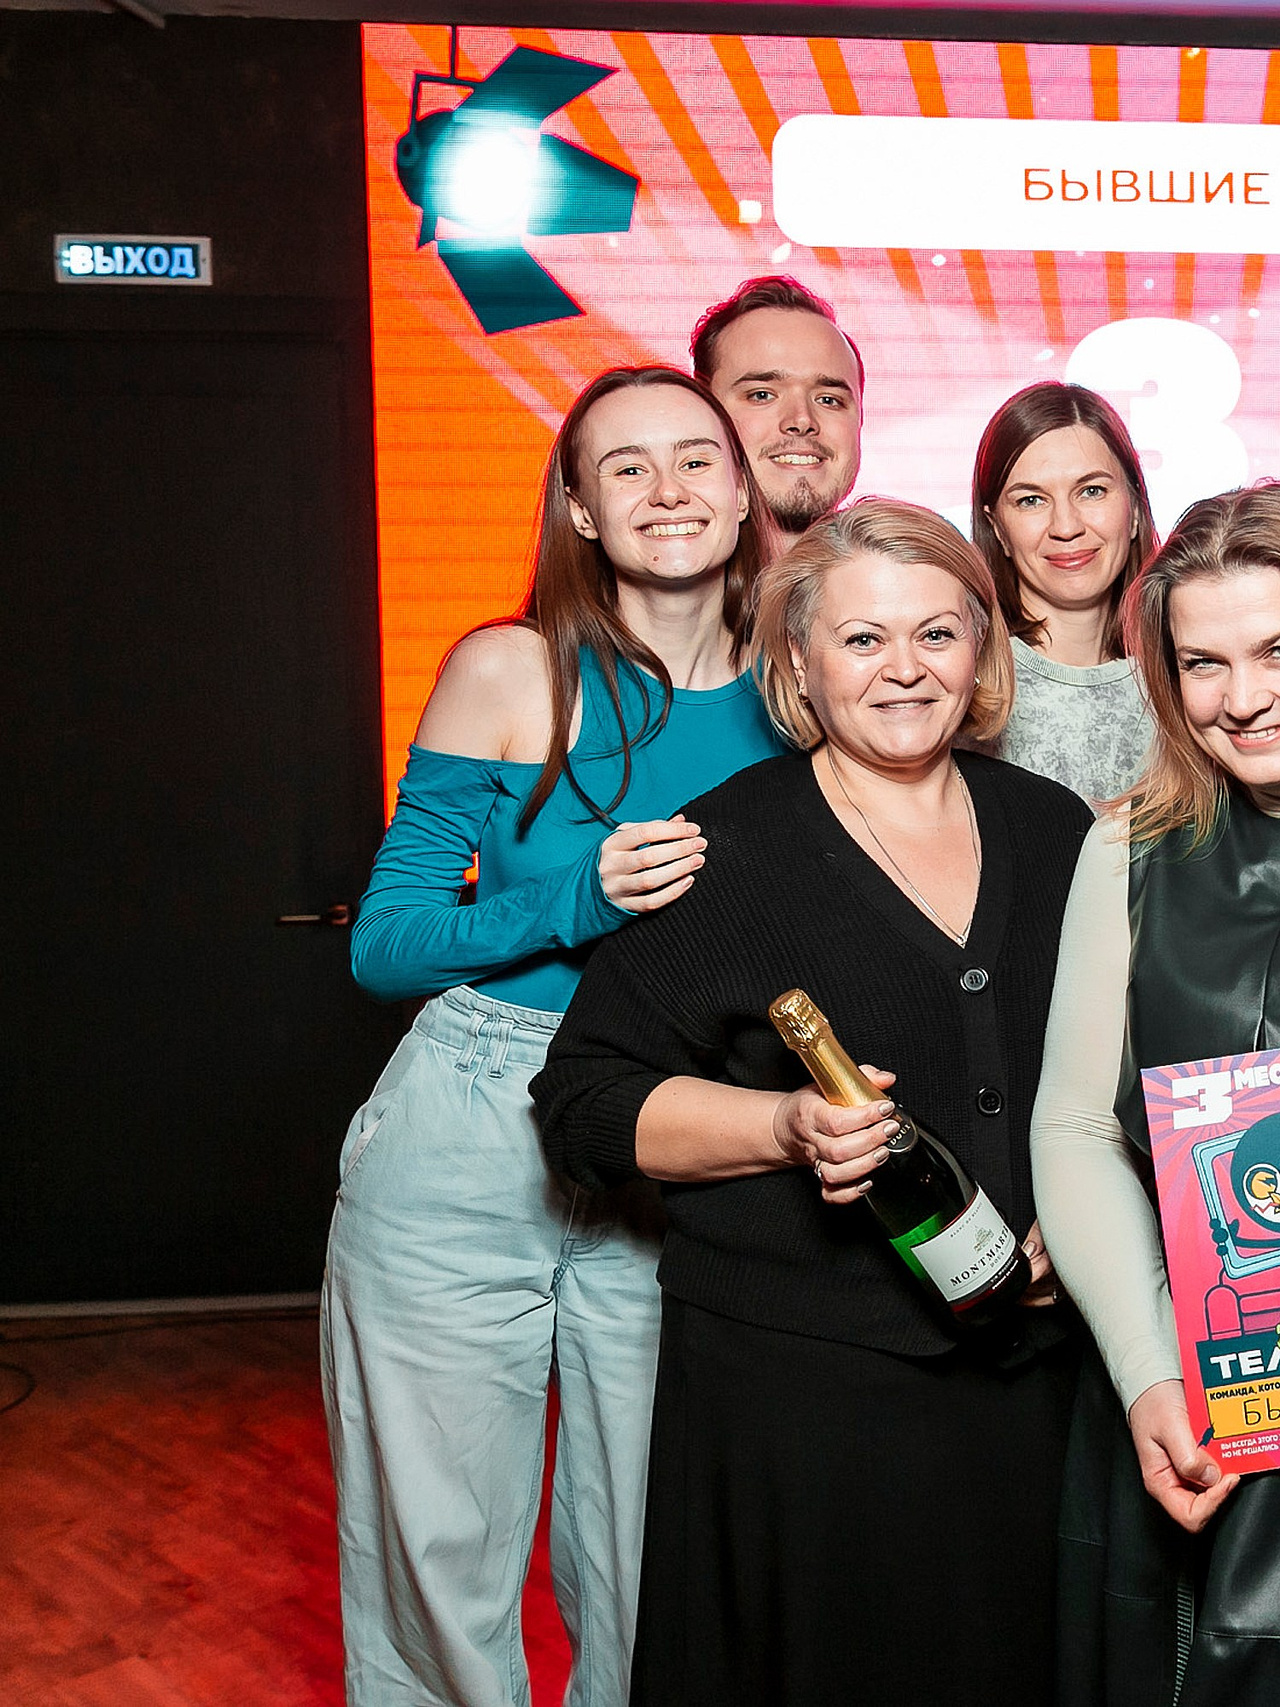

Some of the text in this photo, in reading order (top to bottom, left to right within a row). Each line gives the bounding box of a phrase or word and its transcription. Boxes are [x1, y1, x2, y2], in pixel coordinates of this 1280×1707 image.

[1024, 168, 1270, 204] БЫВШИЕ
[69, 245, 196, 278] ВЫХОД
[1172, 1071, 1233, 1130] 3
[1210, 1386, 1257, 1401] КОМАНДА,
